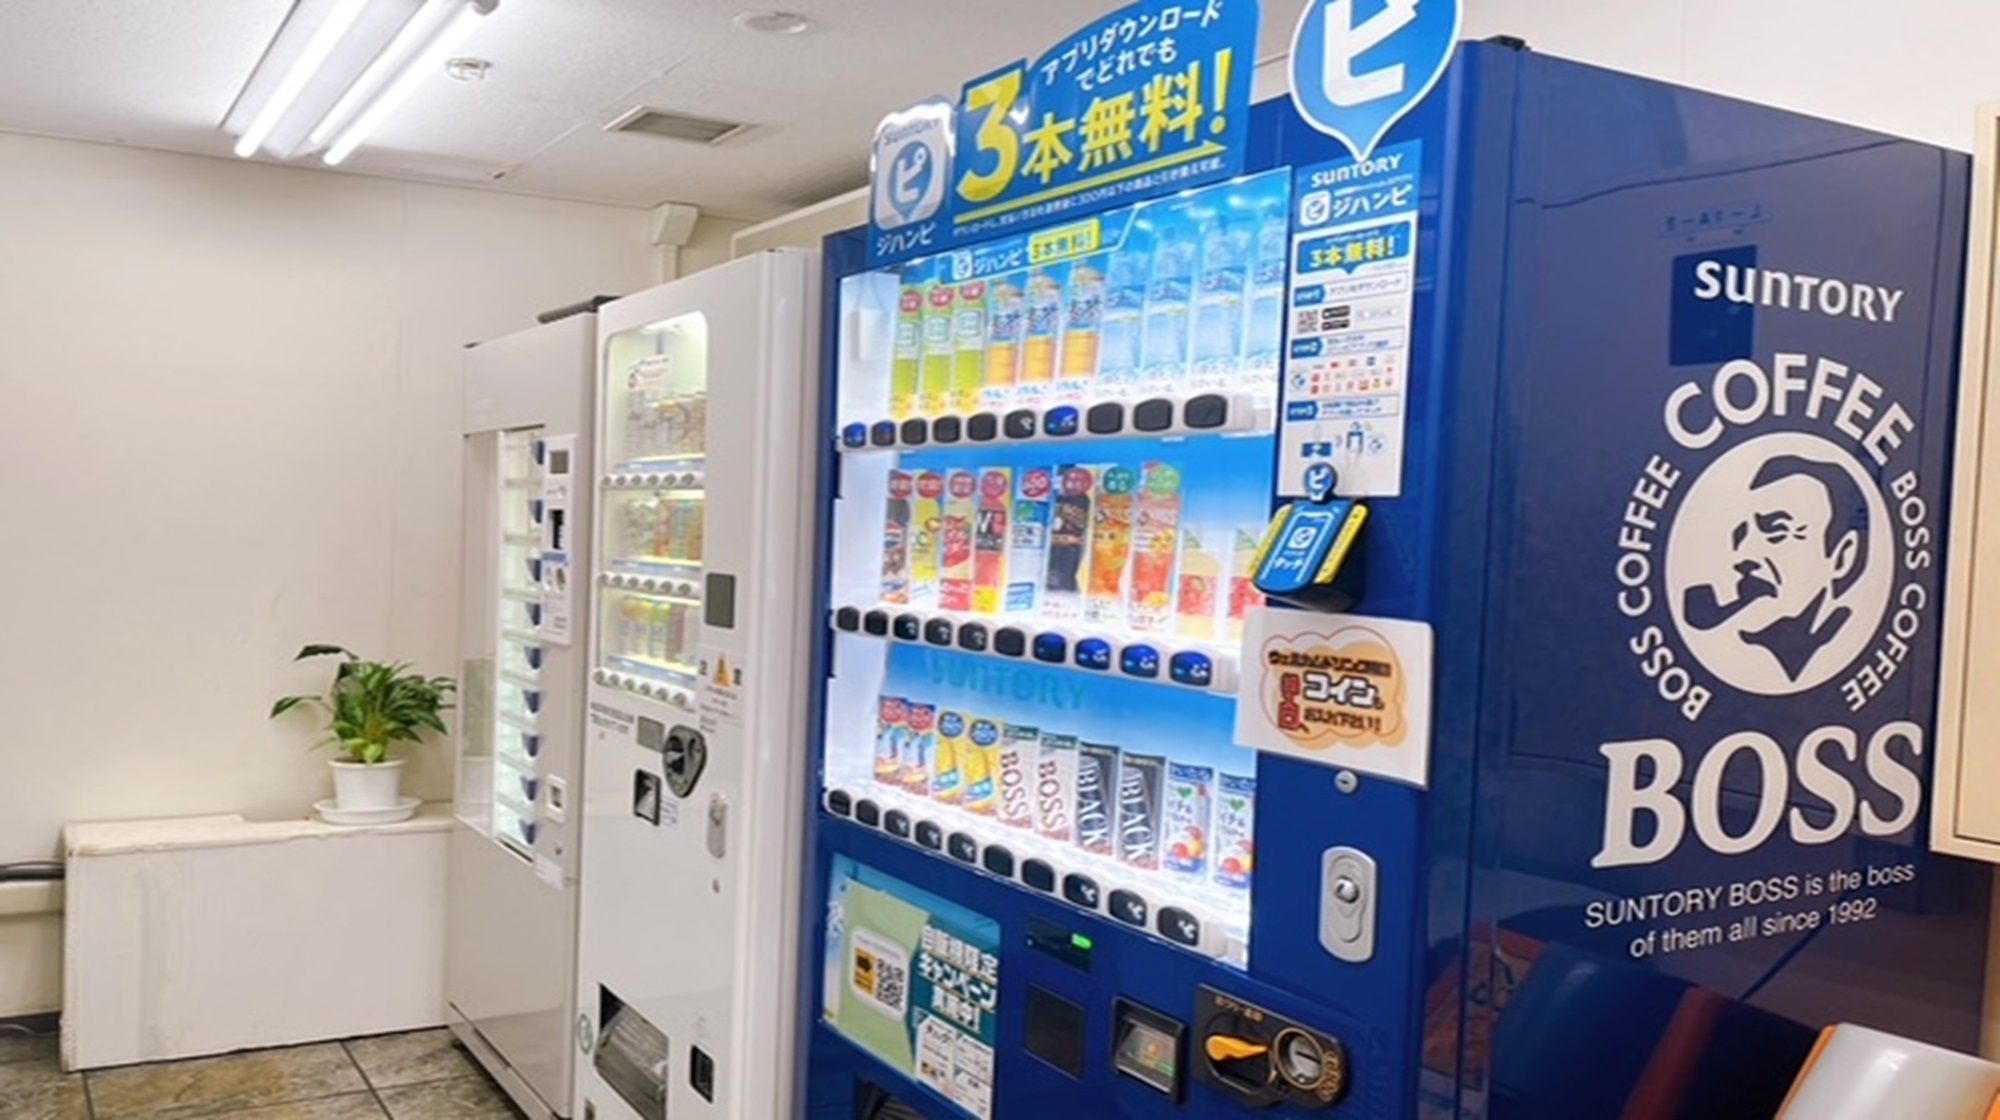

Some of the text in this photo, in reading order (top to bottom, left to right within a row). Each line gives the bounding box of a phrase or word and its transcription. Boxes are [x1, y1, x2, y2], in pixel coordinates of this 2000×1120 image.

[1040, 0, 1223, 85] アプリダウンロード
[1076, 37, 1177, 91] でどれでも
[1333, 184, 1414, 218] ジハンピ
[876, 222, 937, 257] ジハンピ
[1664, 353, 1914, 466] COFFEE
[1616, 455, 1712, 722] BOSS COFFEE
[1841, 470, 1930, 711] BOSS COFFEE
[1001, 752, 1030, 817] BOSS
[1038, 761, 1067, 832] BOSS
[1078, 770, 1109, 847] BLACK
[1120, 781, 1154, 861] BLACK
[1591, 721, 1923, 868] BOSS
[1585, 863, 1916, 928] SUNTORY BOSS is the boss
[1630, 898, 1878, 958] of them all since 1992
